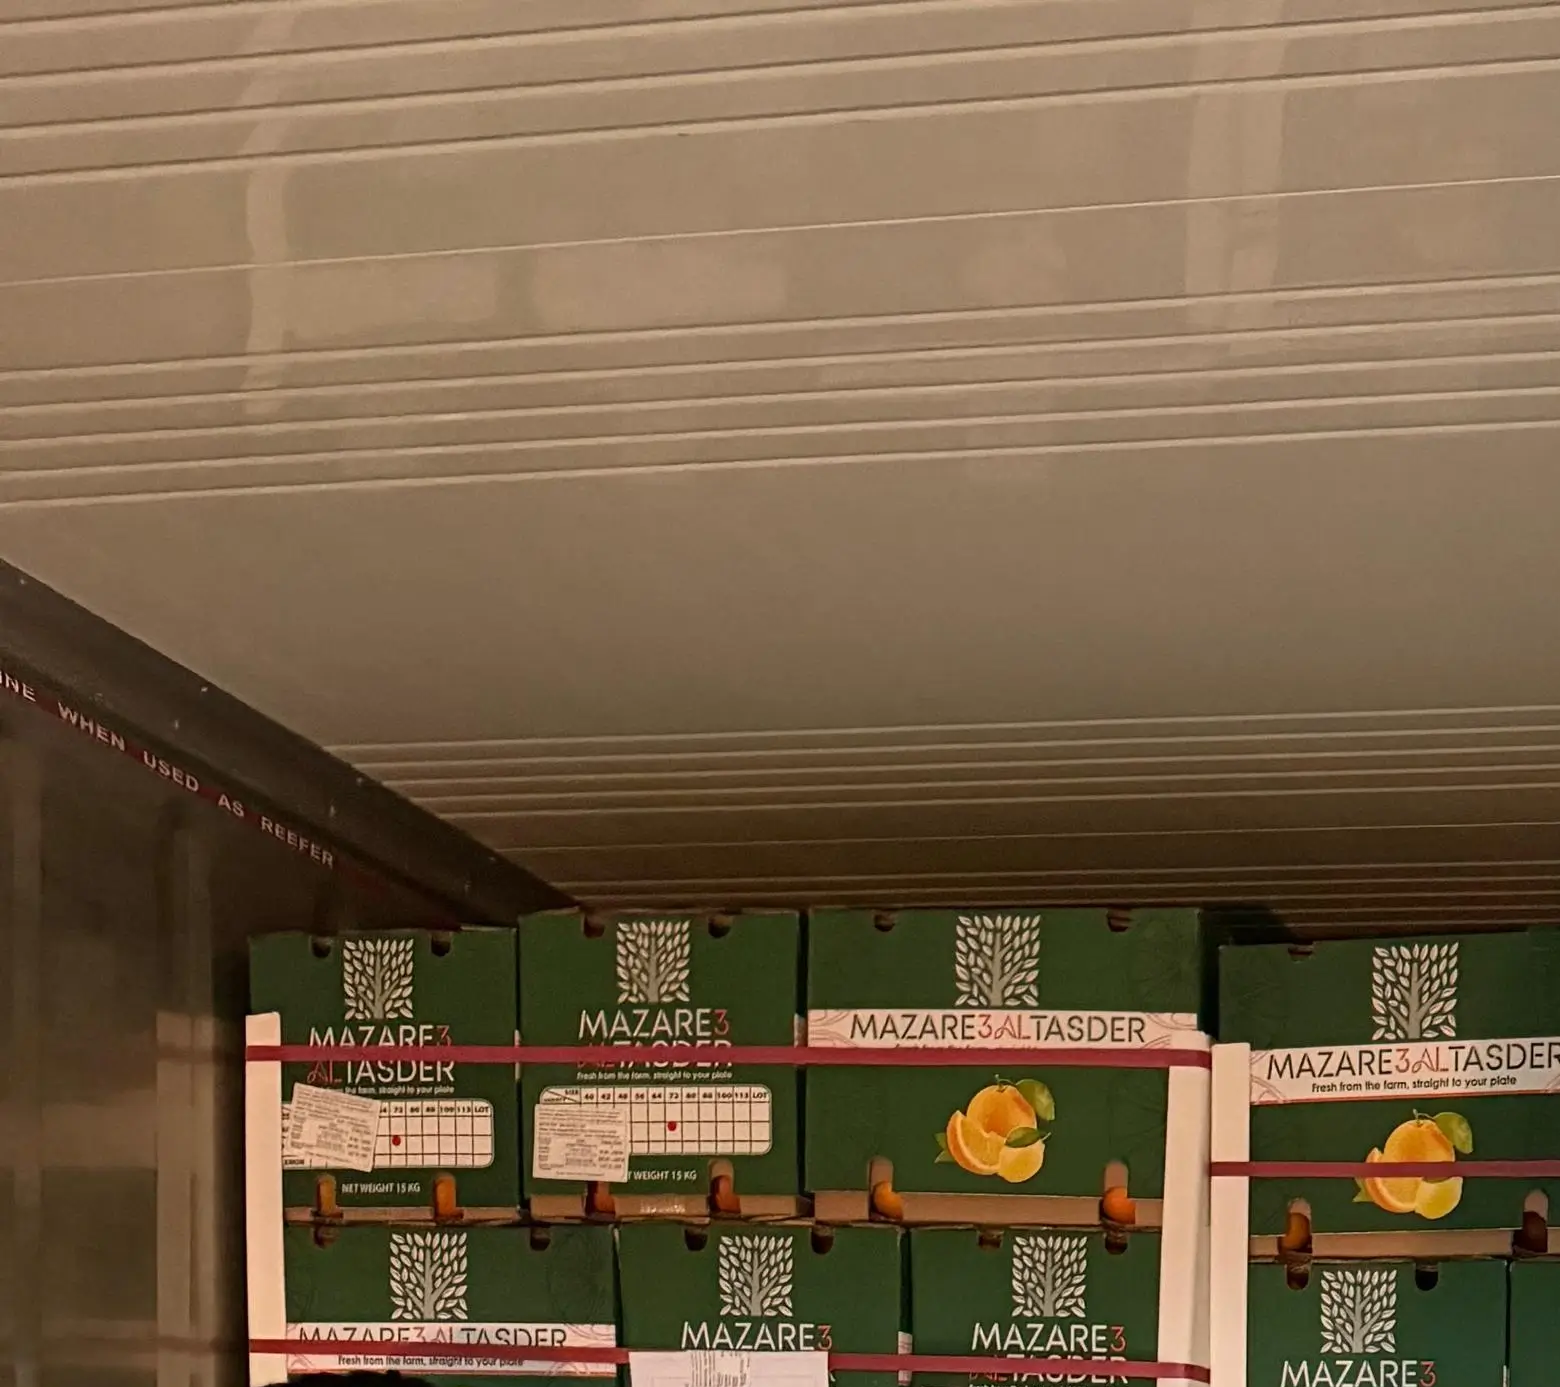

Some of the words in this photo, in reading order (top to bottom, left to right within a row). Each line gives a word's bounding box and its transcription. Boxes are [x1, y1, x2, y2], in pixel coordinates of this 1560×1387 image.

[58, 700, 125, 751] WHEN
[143, 751, 199, 792] USED
[218, 794, 244, 817] AS
[261, 816, 333, 869] REEFER
[578, 1008, 730, 1040] MAZARE3
[850, 1014, 1146, 1043] MAZARE3ALTASDER
[1312, 1082, 1337, 1092] Fresh
[1339, 1082, 1362, 1091] from
[1365, 1081, 1380, 1090] the
[1383, 1080, 1410, 1091] farm,
[1412, 1078, 1449, 1091] straight
[1452, 1079, 1462, 1087] to
[1464, 1080, 1487, 1089] your
[1490, 1076, 1517, 1088] plate
[681, 1322, 833, 1351] MAZARE3
[971, 1322, 1127, 1351] MAZARE3
